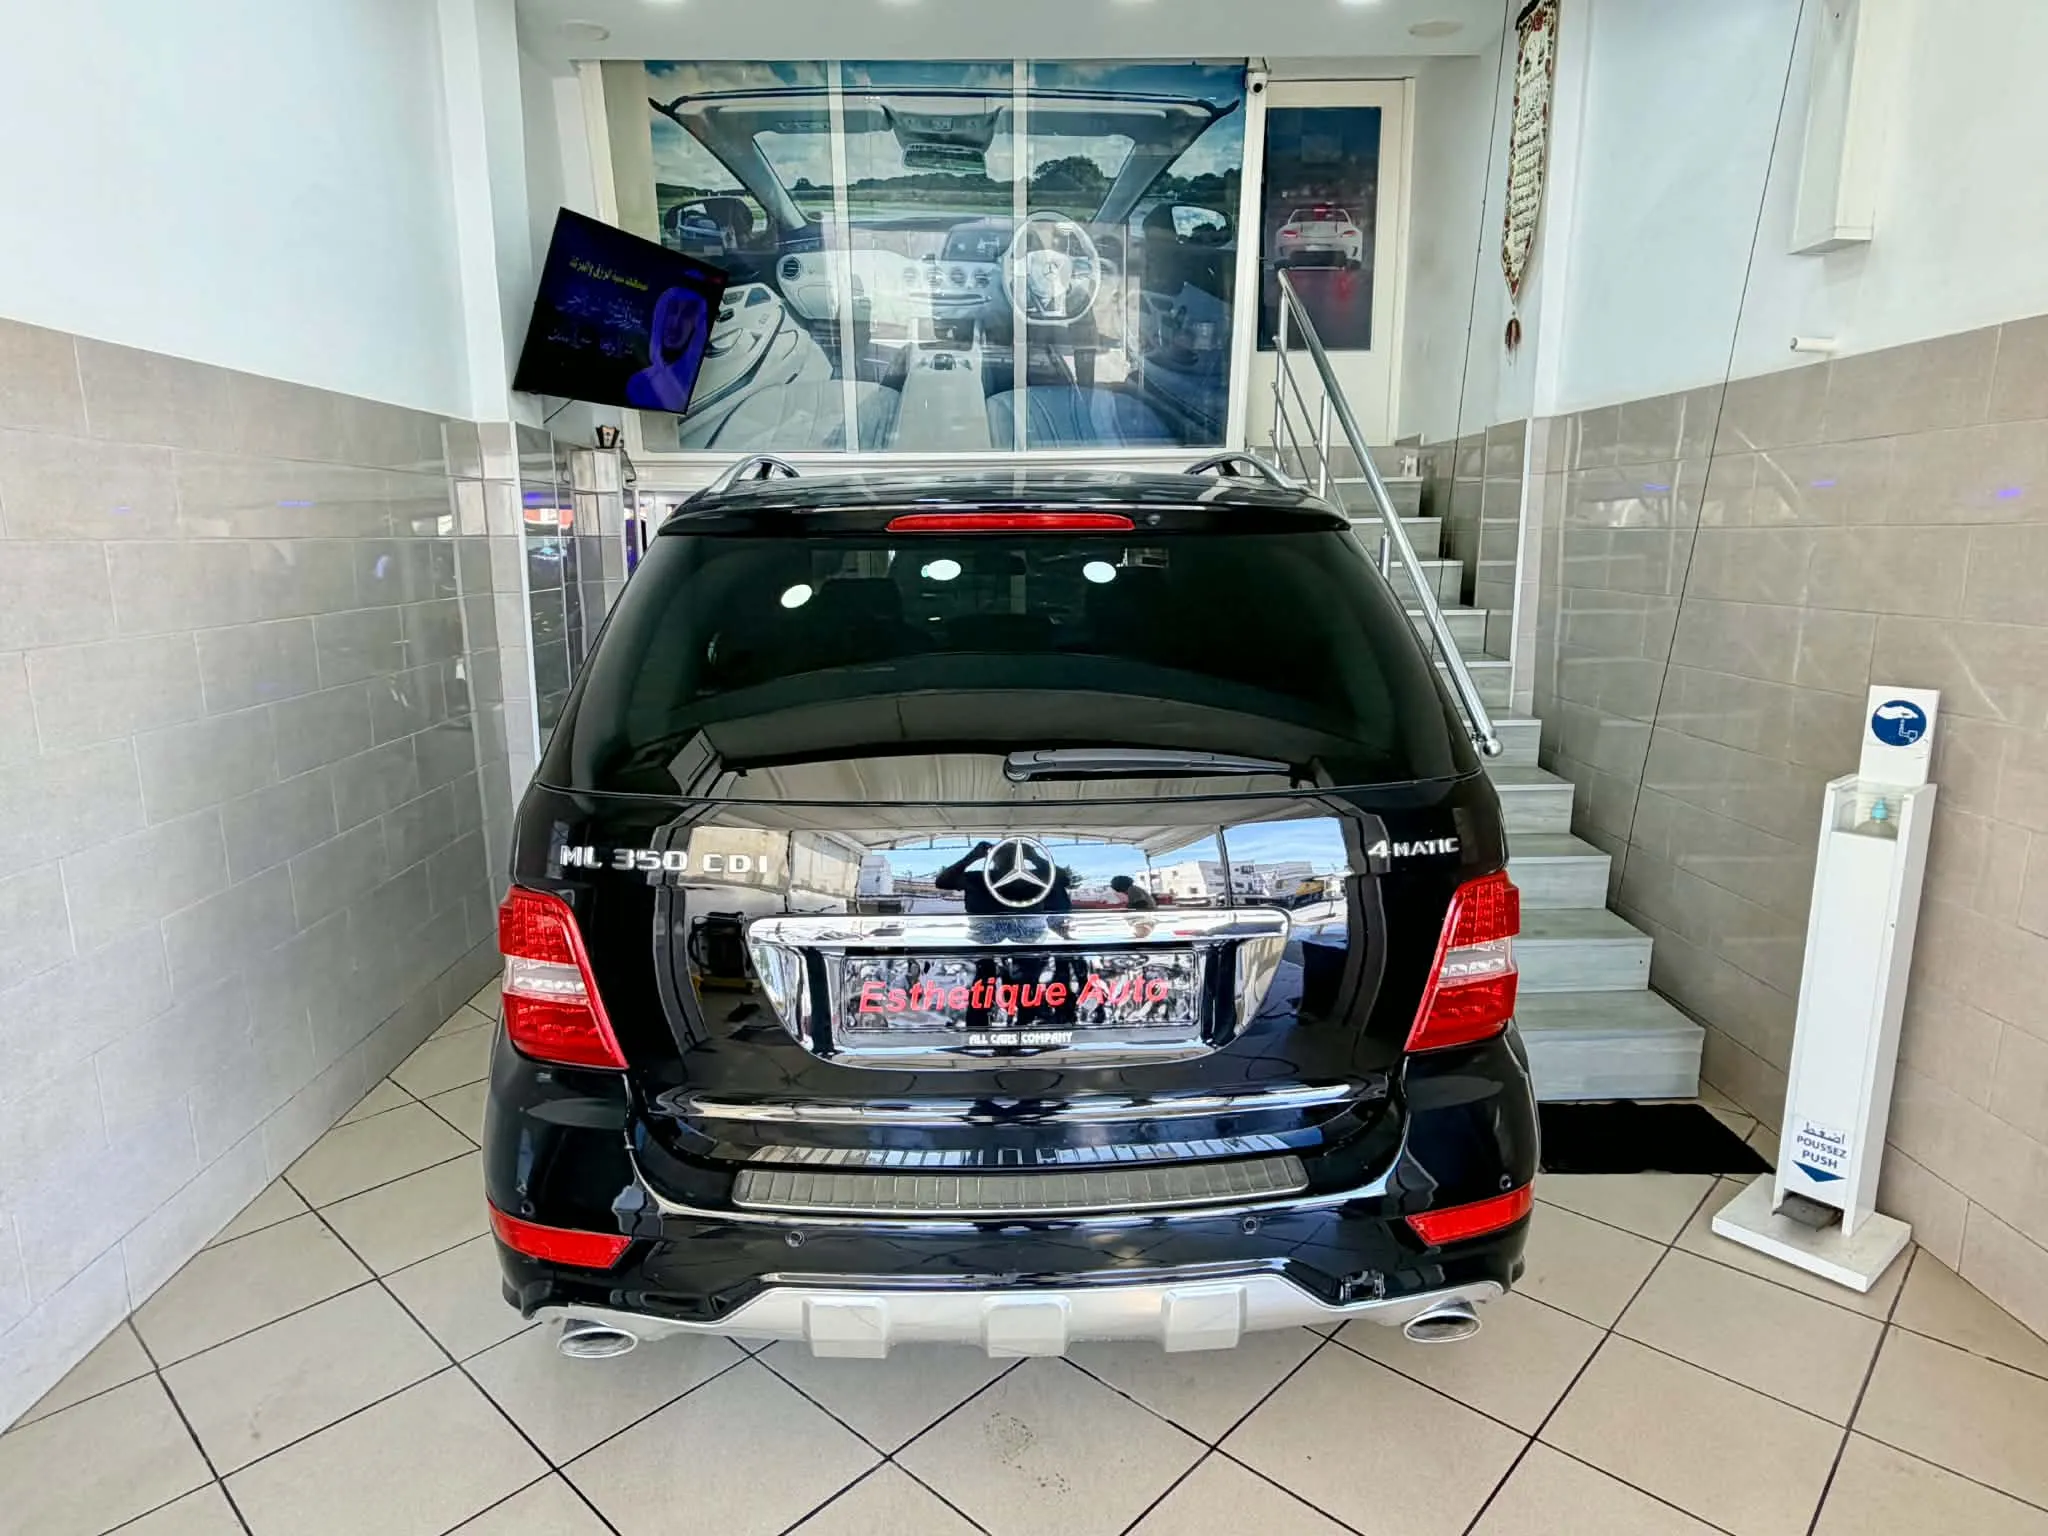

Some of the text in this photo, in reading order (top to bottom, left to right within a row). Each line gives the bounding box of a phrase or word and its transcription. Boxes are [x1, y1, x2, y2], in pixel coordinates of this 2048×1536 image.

[560, 845, 768, 873] ML 350 CDI
[858, 974, 1168, 1016] Esthetique Auto
[969, 1033, 988, 1045] ALL
[1020, 1031, 1073, 1045] COMPANY
[1796, 1135, 1848, 1159] POUSSEZ
[1801, 1149, 1839, 1169] PUSH
